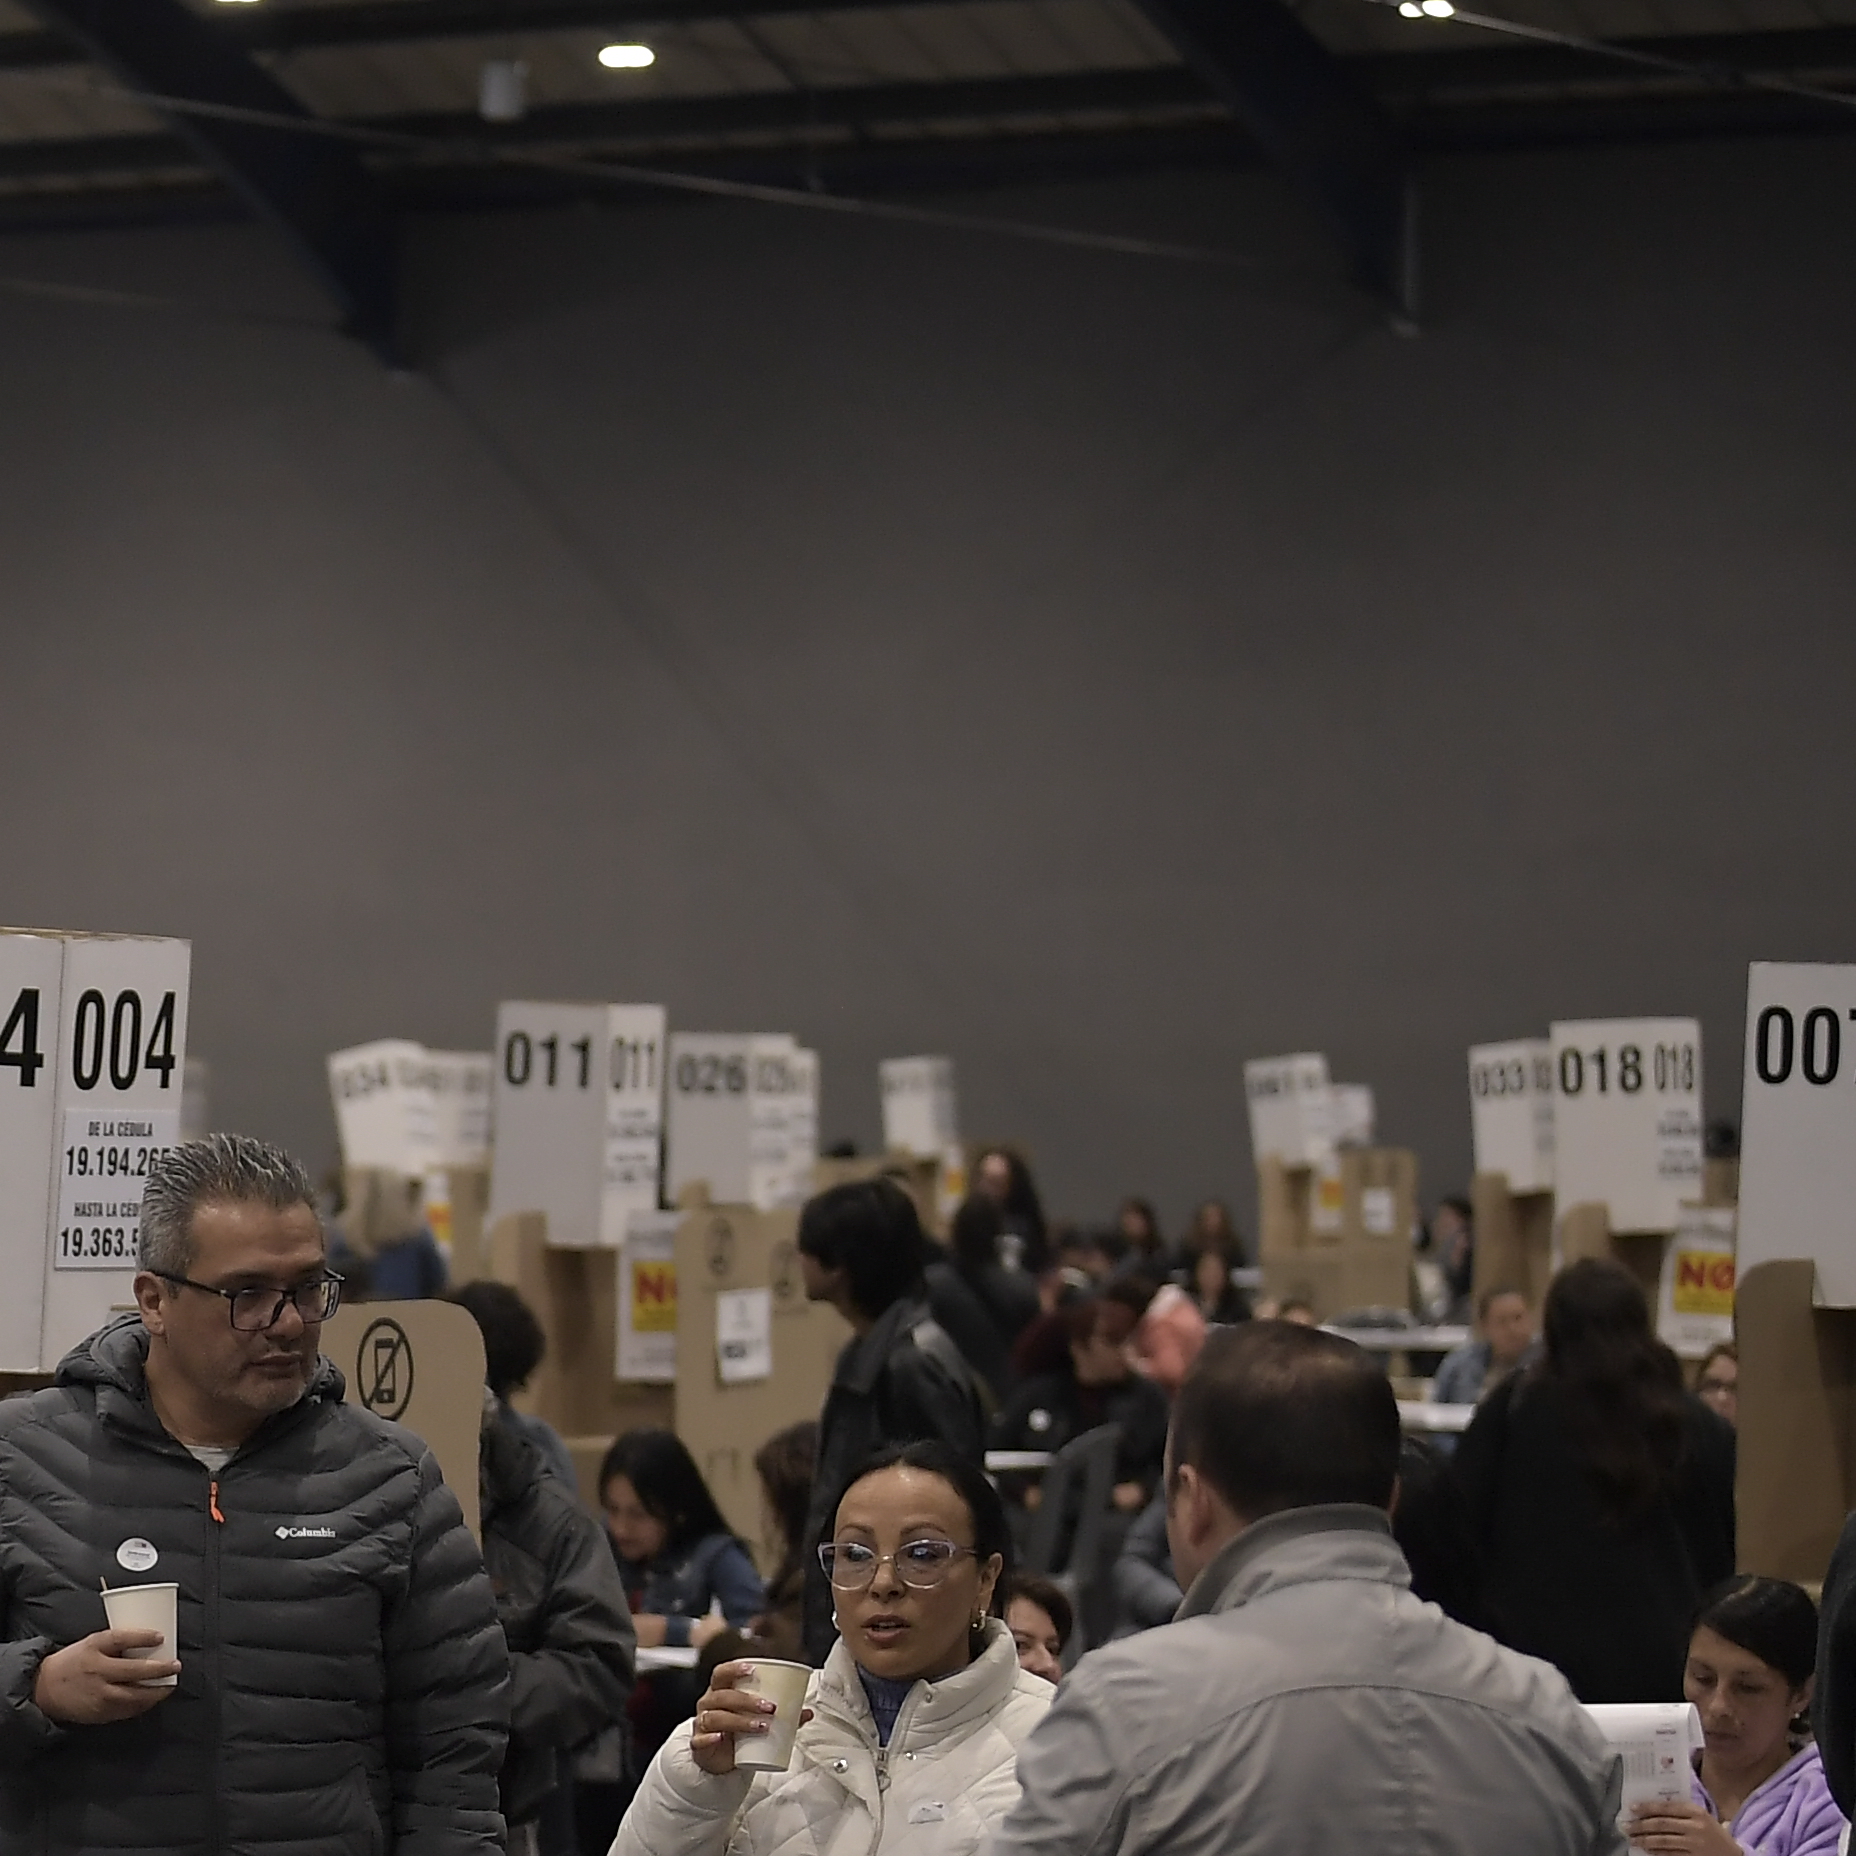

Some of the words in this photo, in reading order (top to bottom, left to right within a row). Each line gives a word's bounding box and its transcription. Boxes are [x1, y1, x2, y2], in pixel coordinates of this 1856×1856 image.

[73, 989, 176, 1090] 004
[506, 1032, 590, 1088] 011
[611, 1036, 655, 1091] 011
[1755, 1005, 1856, 1087] 00
[678, 1054, 746, 1093] 026
[1558, 1043, 1642, 1096] 018
[1653, 1042, 1695, 1092] 018
[88, 1121, 99, 1137] DE
[103, 1121, 115, 1137] LA
[117, 1117, 154, 1137] CÉDULA
[74, 1202, 103, 1217] HASTA
[106, 1202, 118, 1217] LA
[288, 1527, 336, 1538] Columbia
